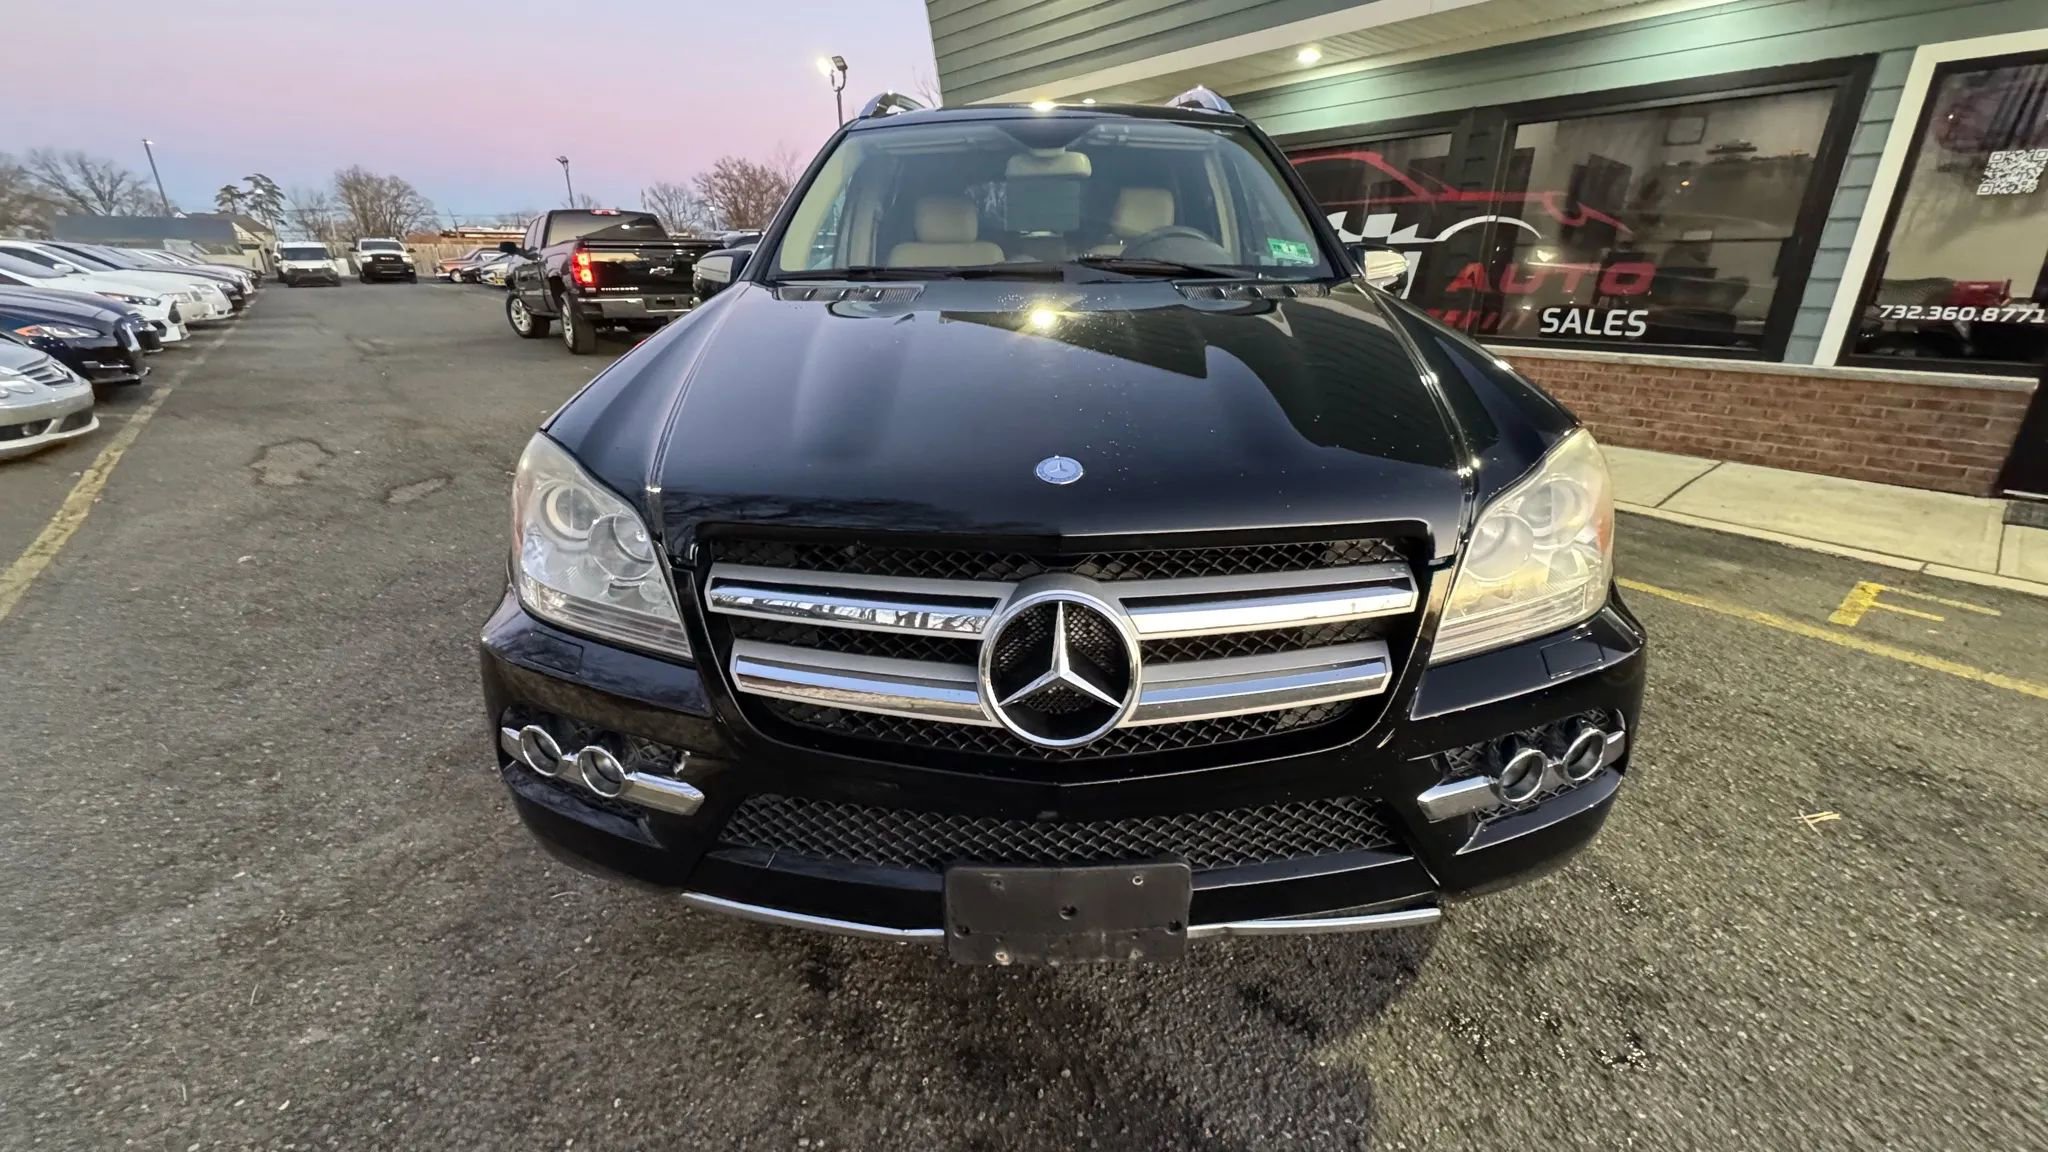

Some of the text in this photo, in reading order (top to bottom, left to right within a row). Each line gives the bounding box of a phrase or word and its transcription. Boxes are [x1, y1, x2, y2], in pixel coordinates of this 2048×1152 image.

[1445, 262, 1656, 295] AUTO
[1540, 308, 1649, 336] SALES
[1879, 304, 2046, 324] 732.360.8771
